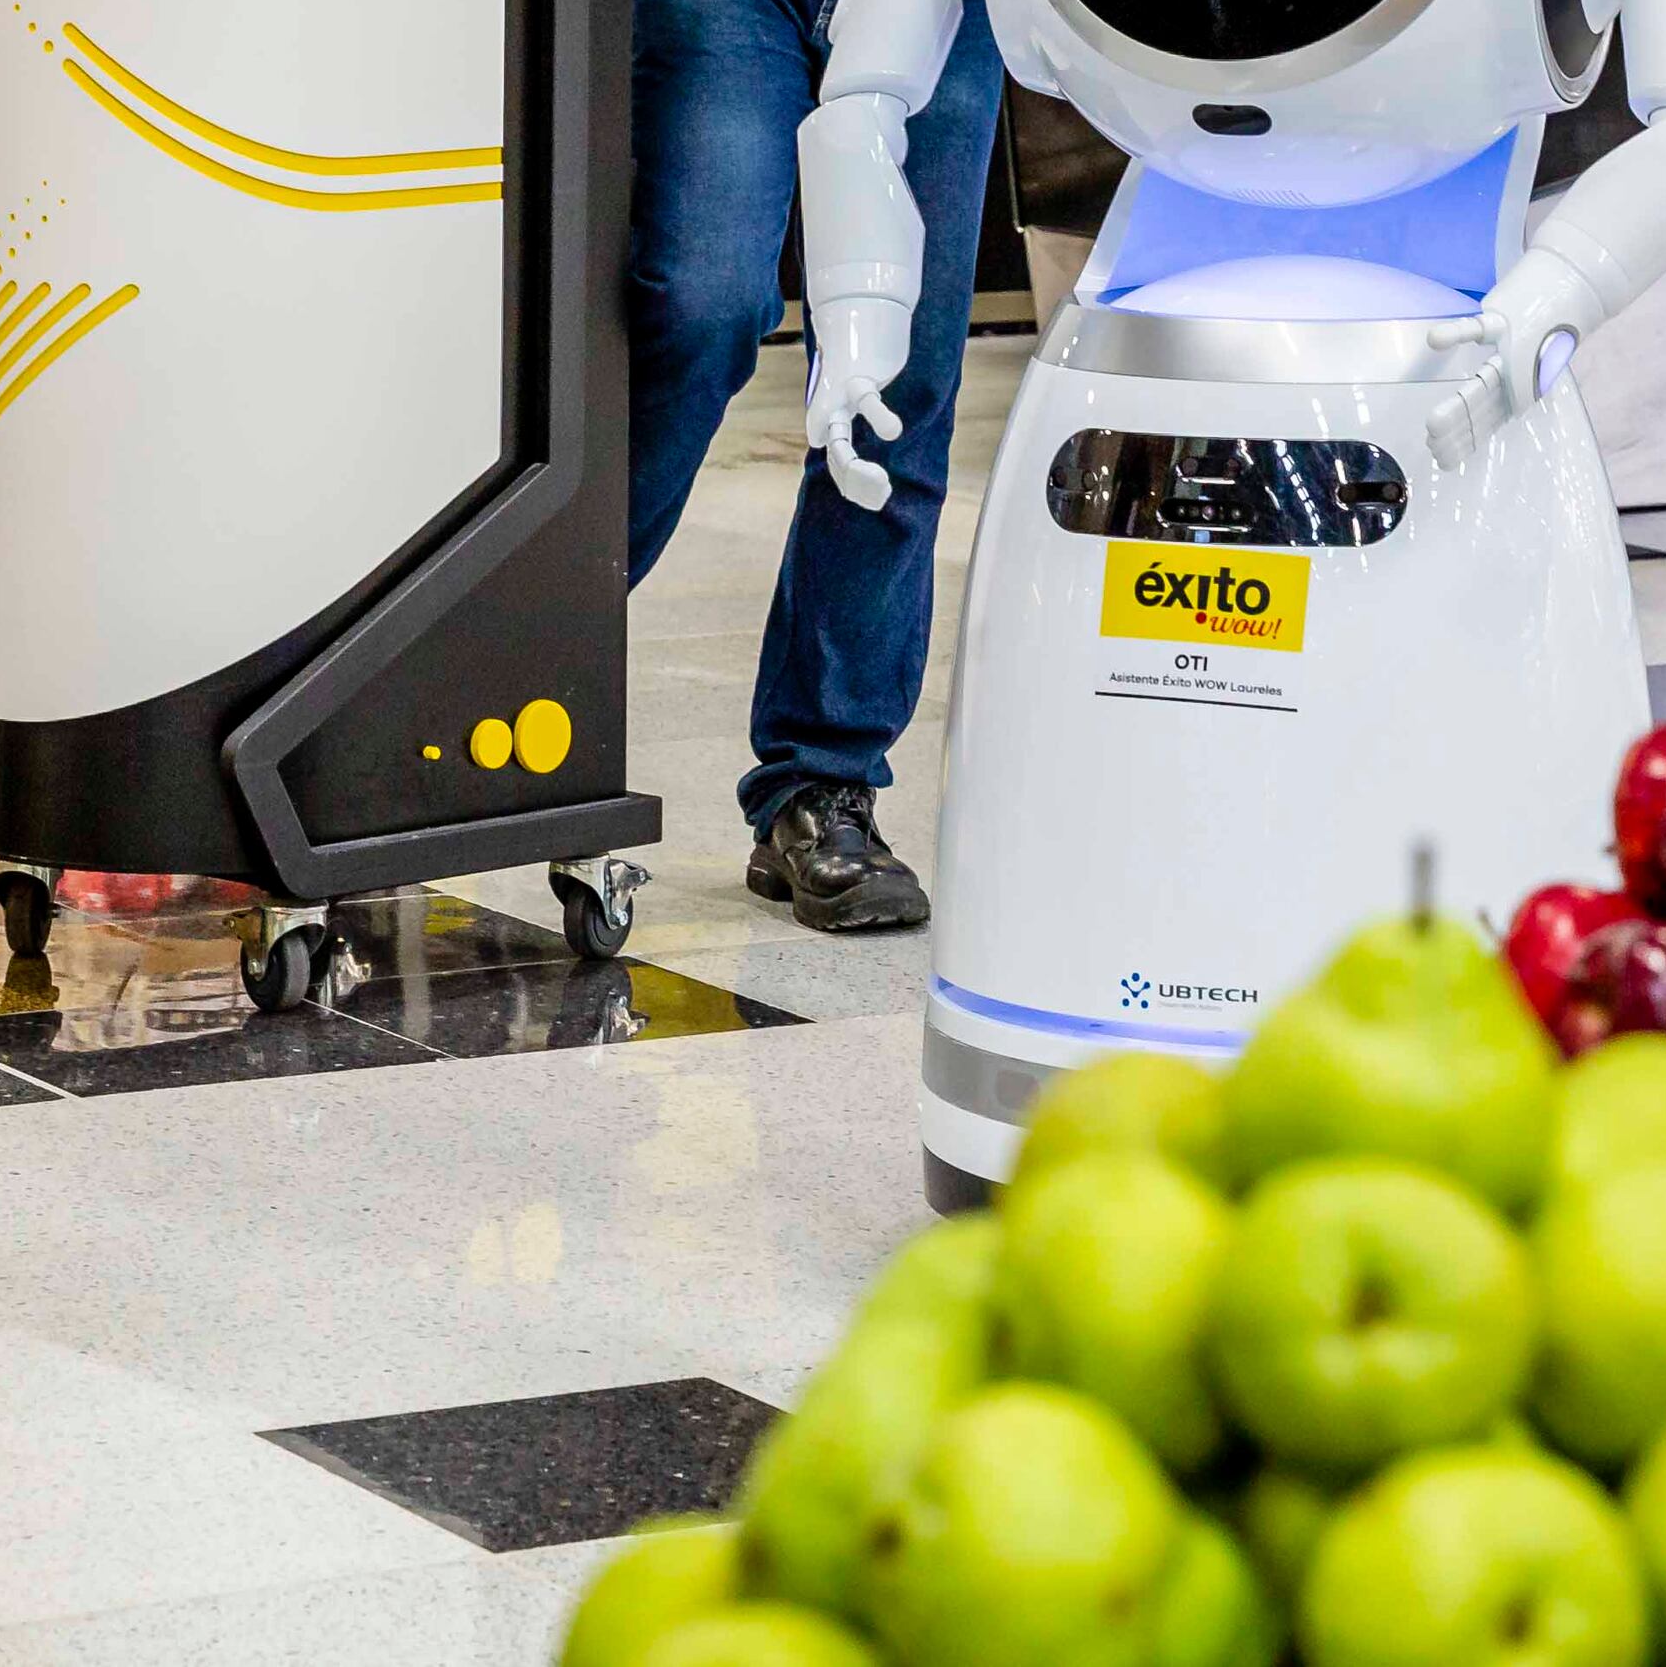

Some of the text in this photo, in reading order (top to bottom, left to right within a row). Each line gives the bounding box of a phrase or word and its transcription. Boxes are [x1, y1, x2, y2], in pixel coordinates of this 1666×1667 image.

[1134, 562, 1271, 624] éxito
[1209, 616, 1282, 640] wow!
[1174, 654, 1208, 672] OTI
[1109, 672, 1283, 696] Asistente Éxito WOW Laureles
[1158, 984, 1259, 1003] UBTECH
